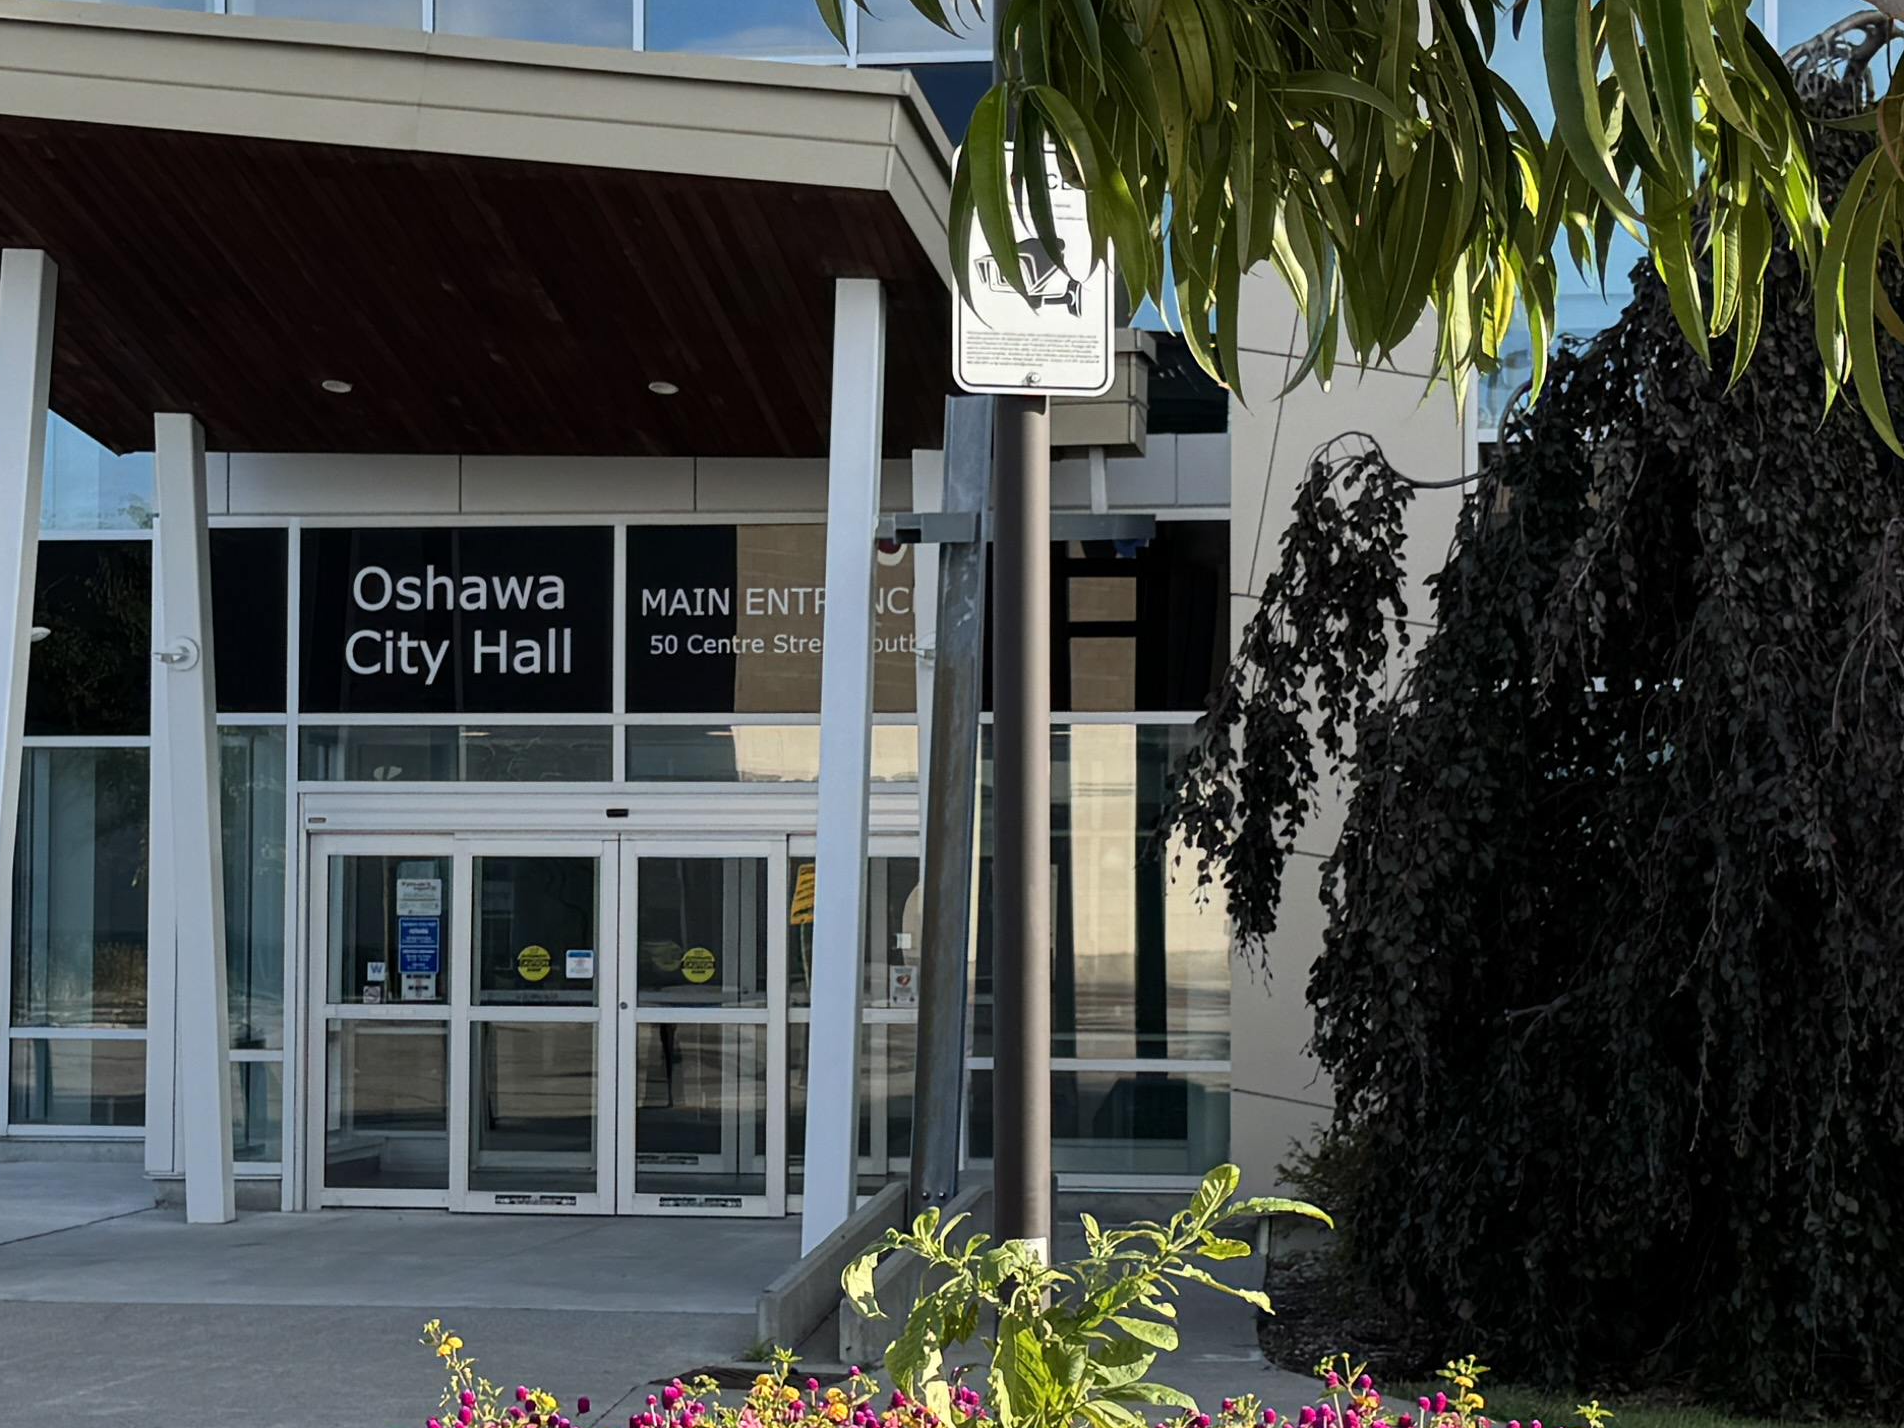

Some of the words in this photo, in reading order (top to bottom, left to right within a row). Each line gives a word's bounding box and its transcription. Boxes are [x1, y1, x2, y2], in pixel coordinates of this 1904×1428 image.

[352, 564, 565, 612] Oshawa
[641, 587, 730, 617] MAIN
[345, 629, 450, 686] City
[473, 627, 572, 674] Hall
[650, 634, 678, 655] 50
[686, 634, 765, 655] Centre
